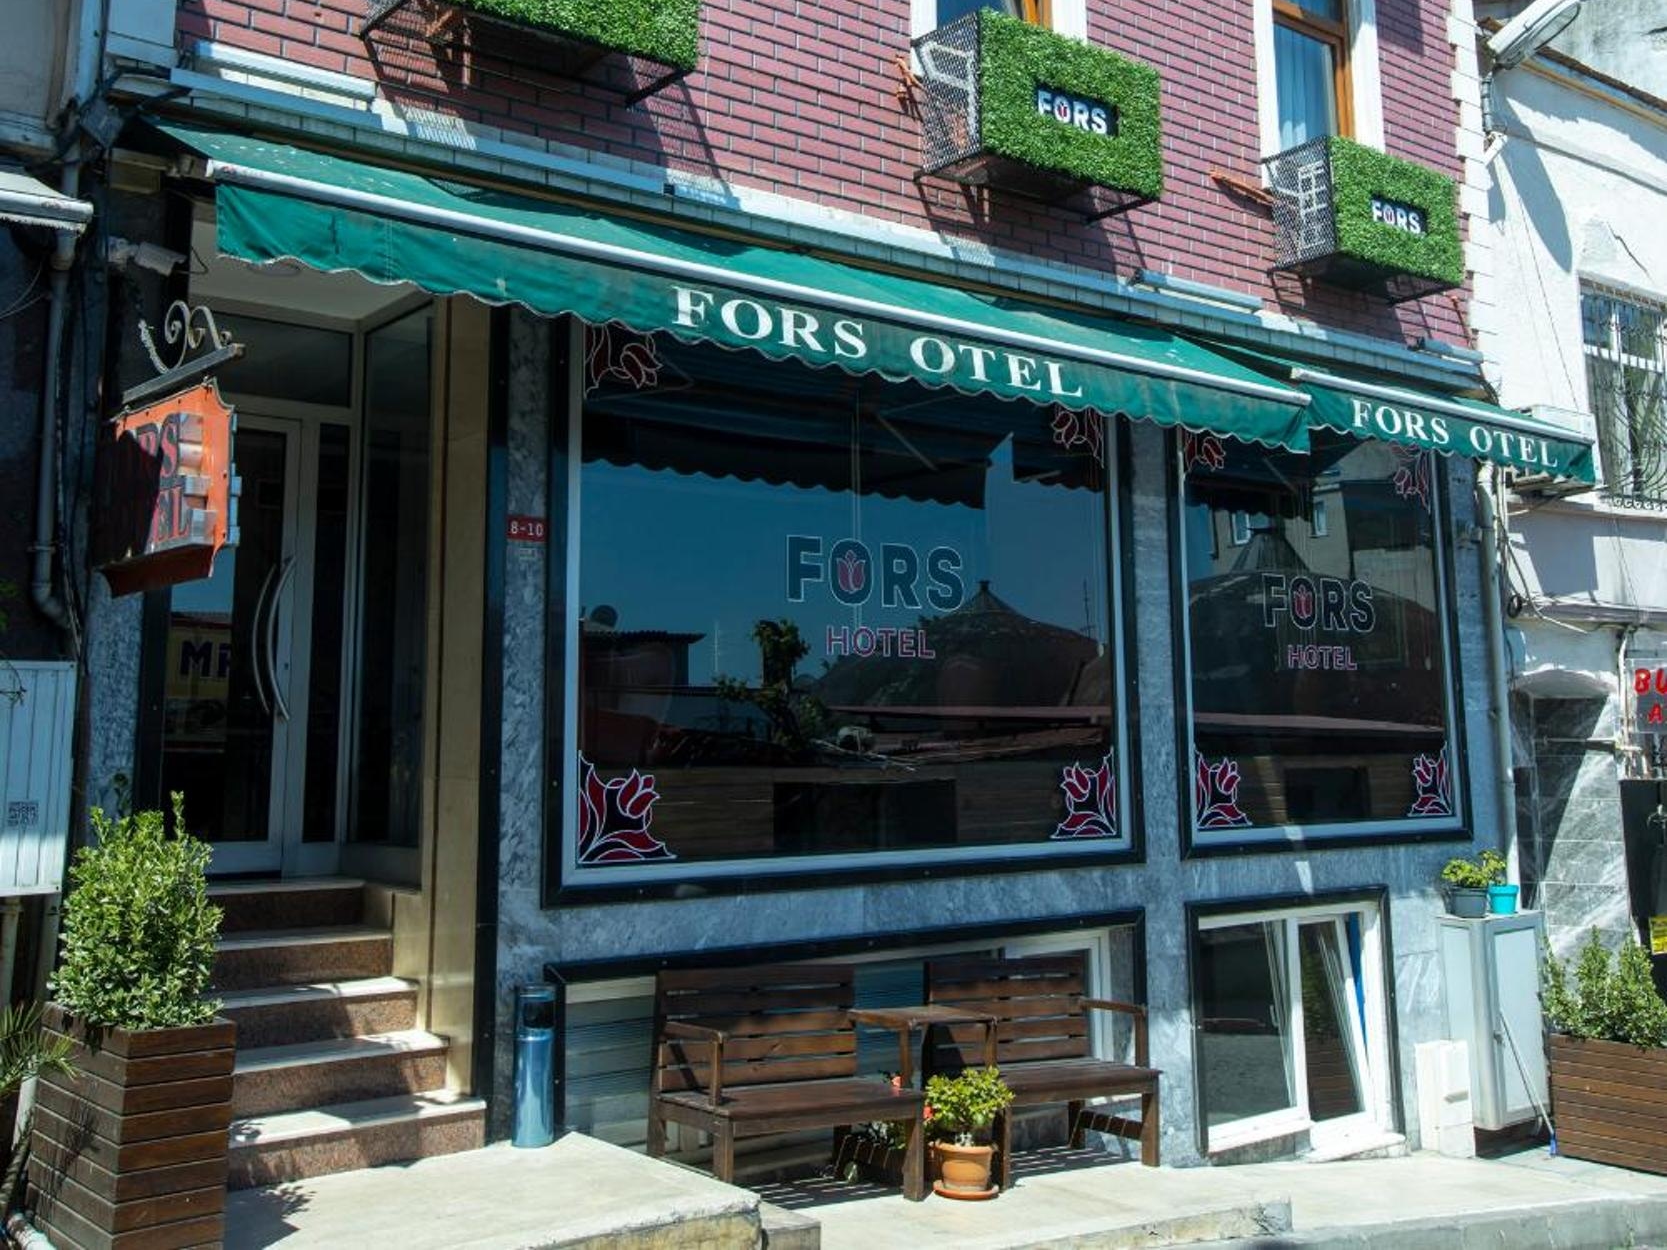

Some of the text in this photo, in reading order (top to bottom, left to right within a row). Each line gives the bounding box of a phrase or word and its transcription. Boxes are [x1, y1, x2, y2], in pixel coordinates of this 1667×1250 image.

[1038, 89, 1107, 134] FORS
[1371, 200, 1421, 234] FORS
[672, 286, 1082, 398] FORS OTEL
[1351, 399, 1558, 468] FORS OTEL
[511, 520, 544, 538] 8-10
[786, 534, 964, 613] FORS
[1262, 572, 1376, 633] FORS
[826, 625, 936, 660] HOTEL
[1287, 643, 1358, 671] HOTEL
